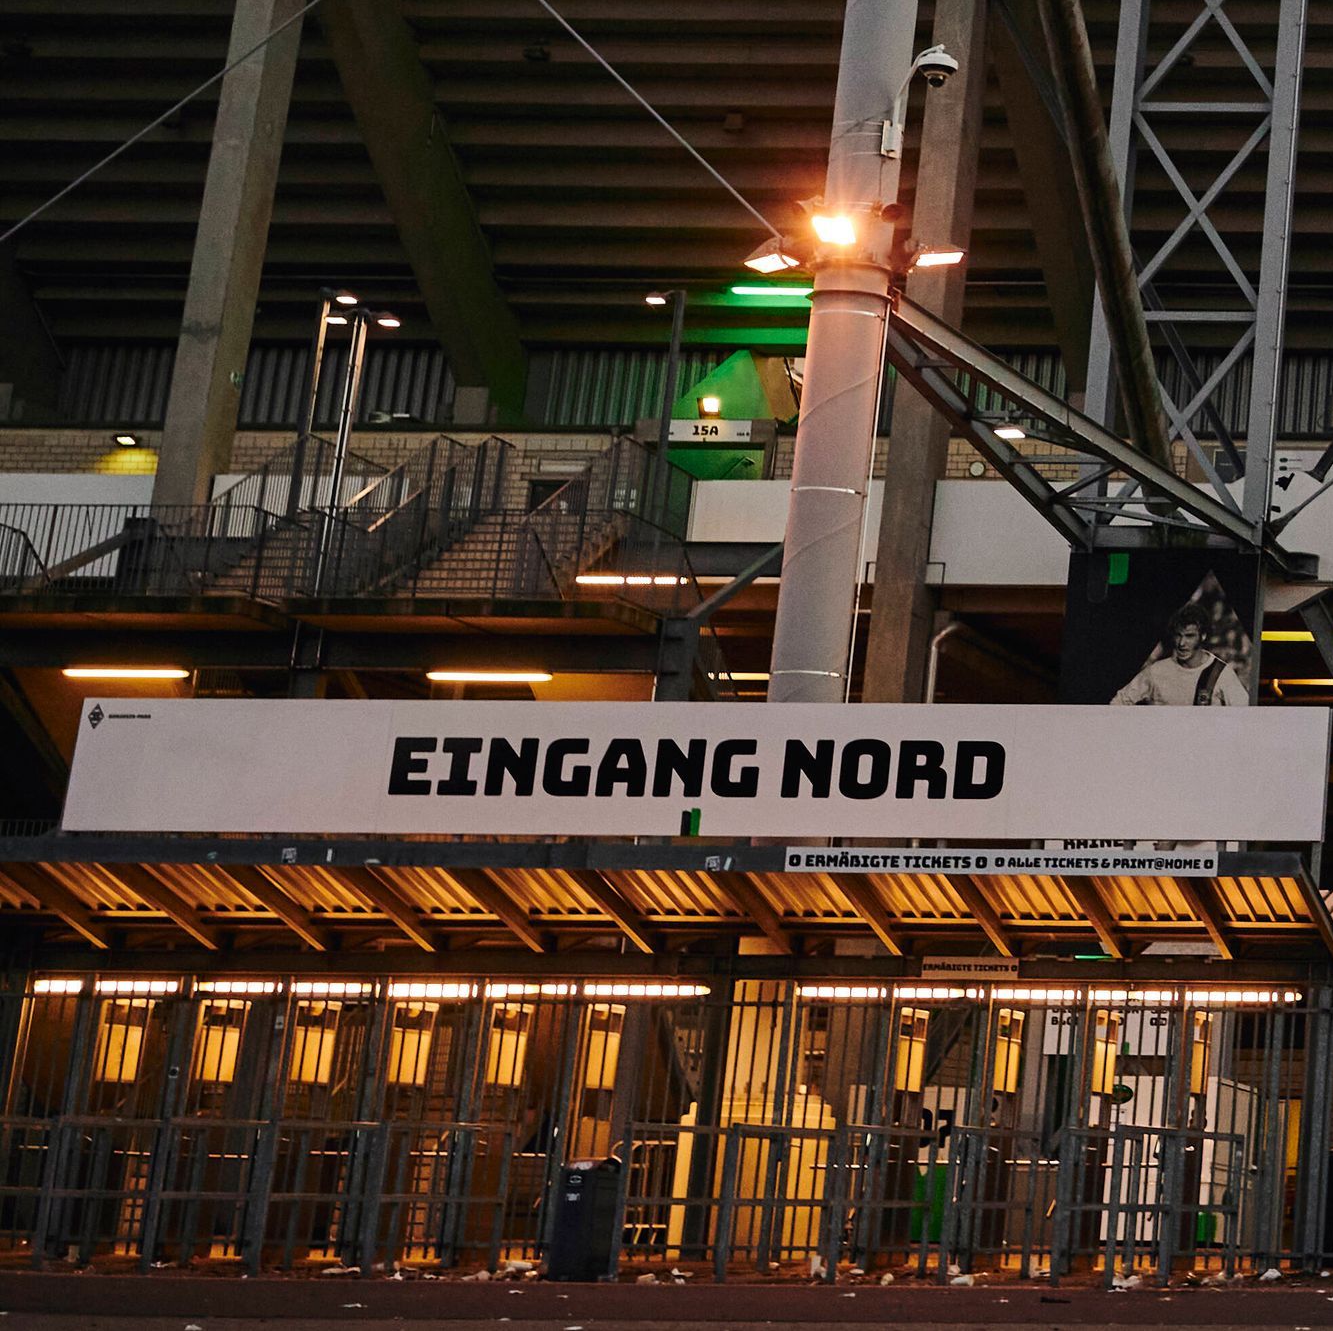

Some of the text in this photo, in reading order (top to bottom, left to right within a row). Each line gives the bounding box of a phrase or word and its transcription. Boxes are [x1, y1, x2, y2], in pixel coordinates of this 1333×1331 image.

[692, 425, 719, 436] 15A
[388, 736, 1006, 800] EINGANG NORD
[903, 856, 972, 869] TICKETS
[1008, 857, 1042, 868] ALLE
[1044, 858, 1099, 869] TICKETS
[1113, 857, 1201, 870] PRINT@HOME
[974, 964, 1009, 972] TICKETS
